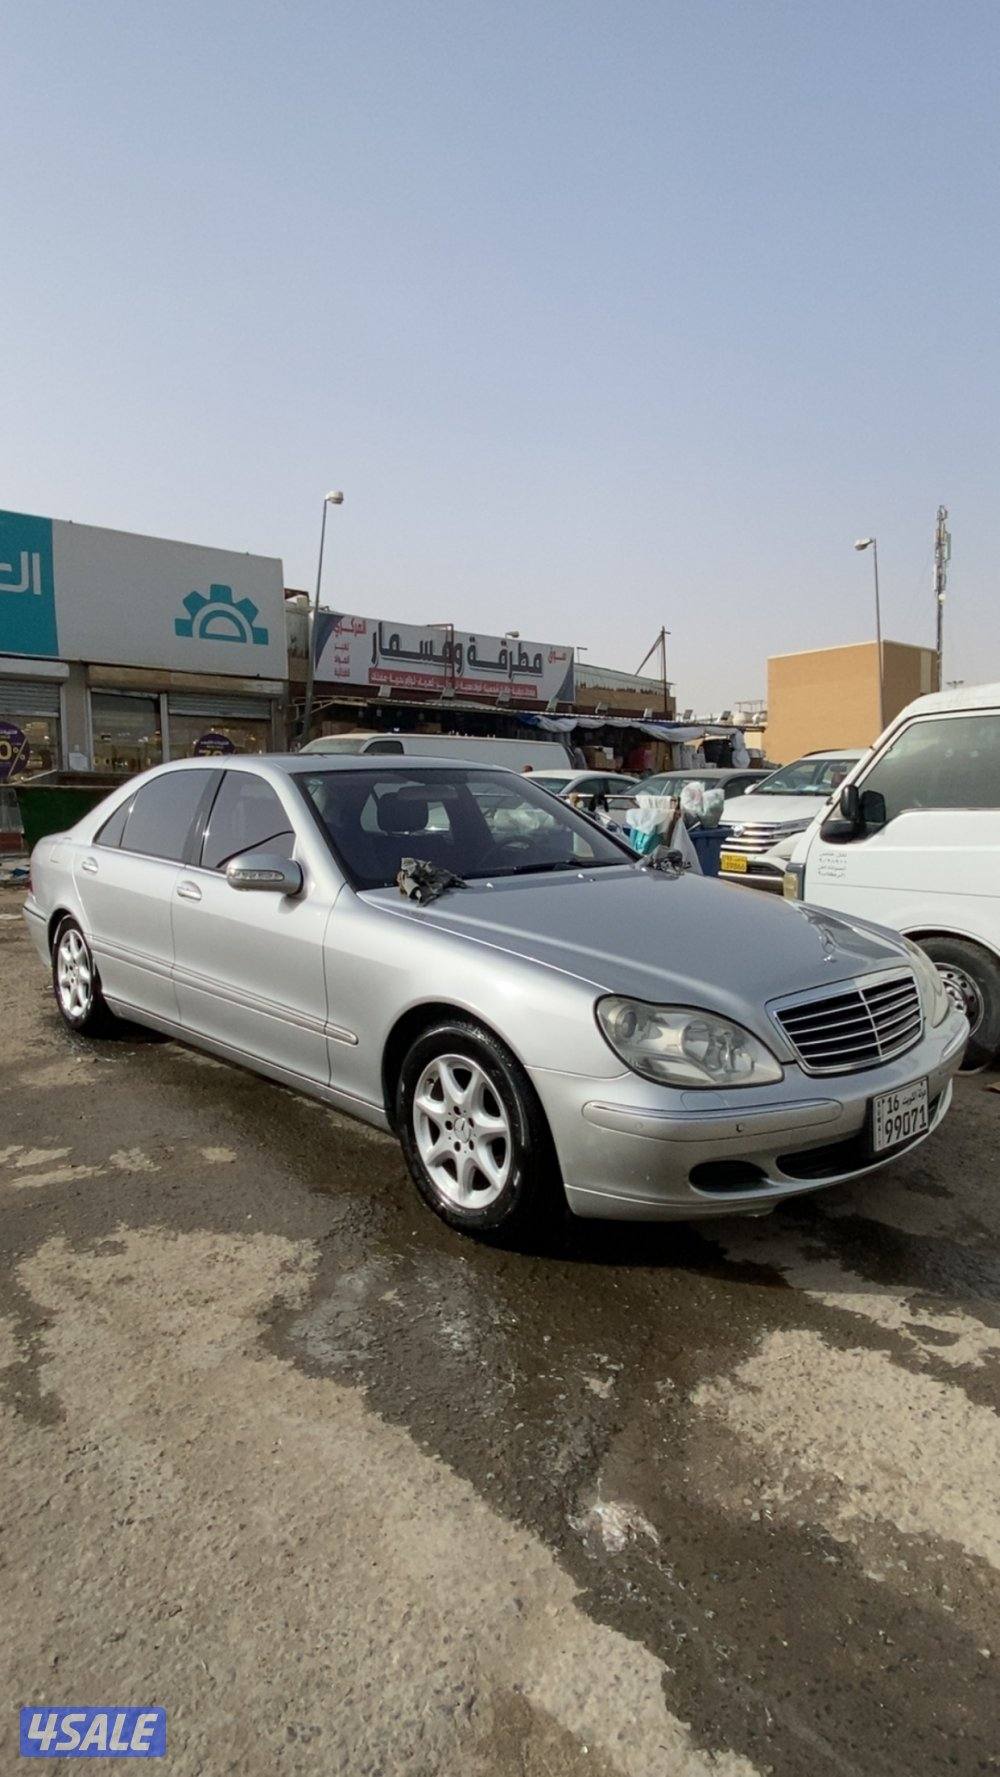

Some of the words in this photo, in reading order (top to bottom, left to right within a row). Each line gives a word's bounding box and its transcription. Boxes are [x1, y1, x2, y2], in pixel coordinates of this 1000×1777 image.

[371, 621, 465, 676] ومسمار
[467, 637, 543, 681] مطرقة
[885, 1104, 926, 1143] 99071
[887, 1095, 899, 1114] 16
